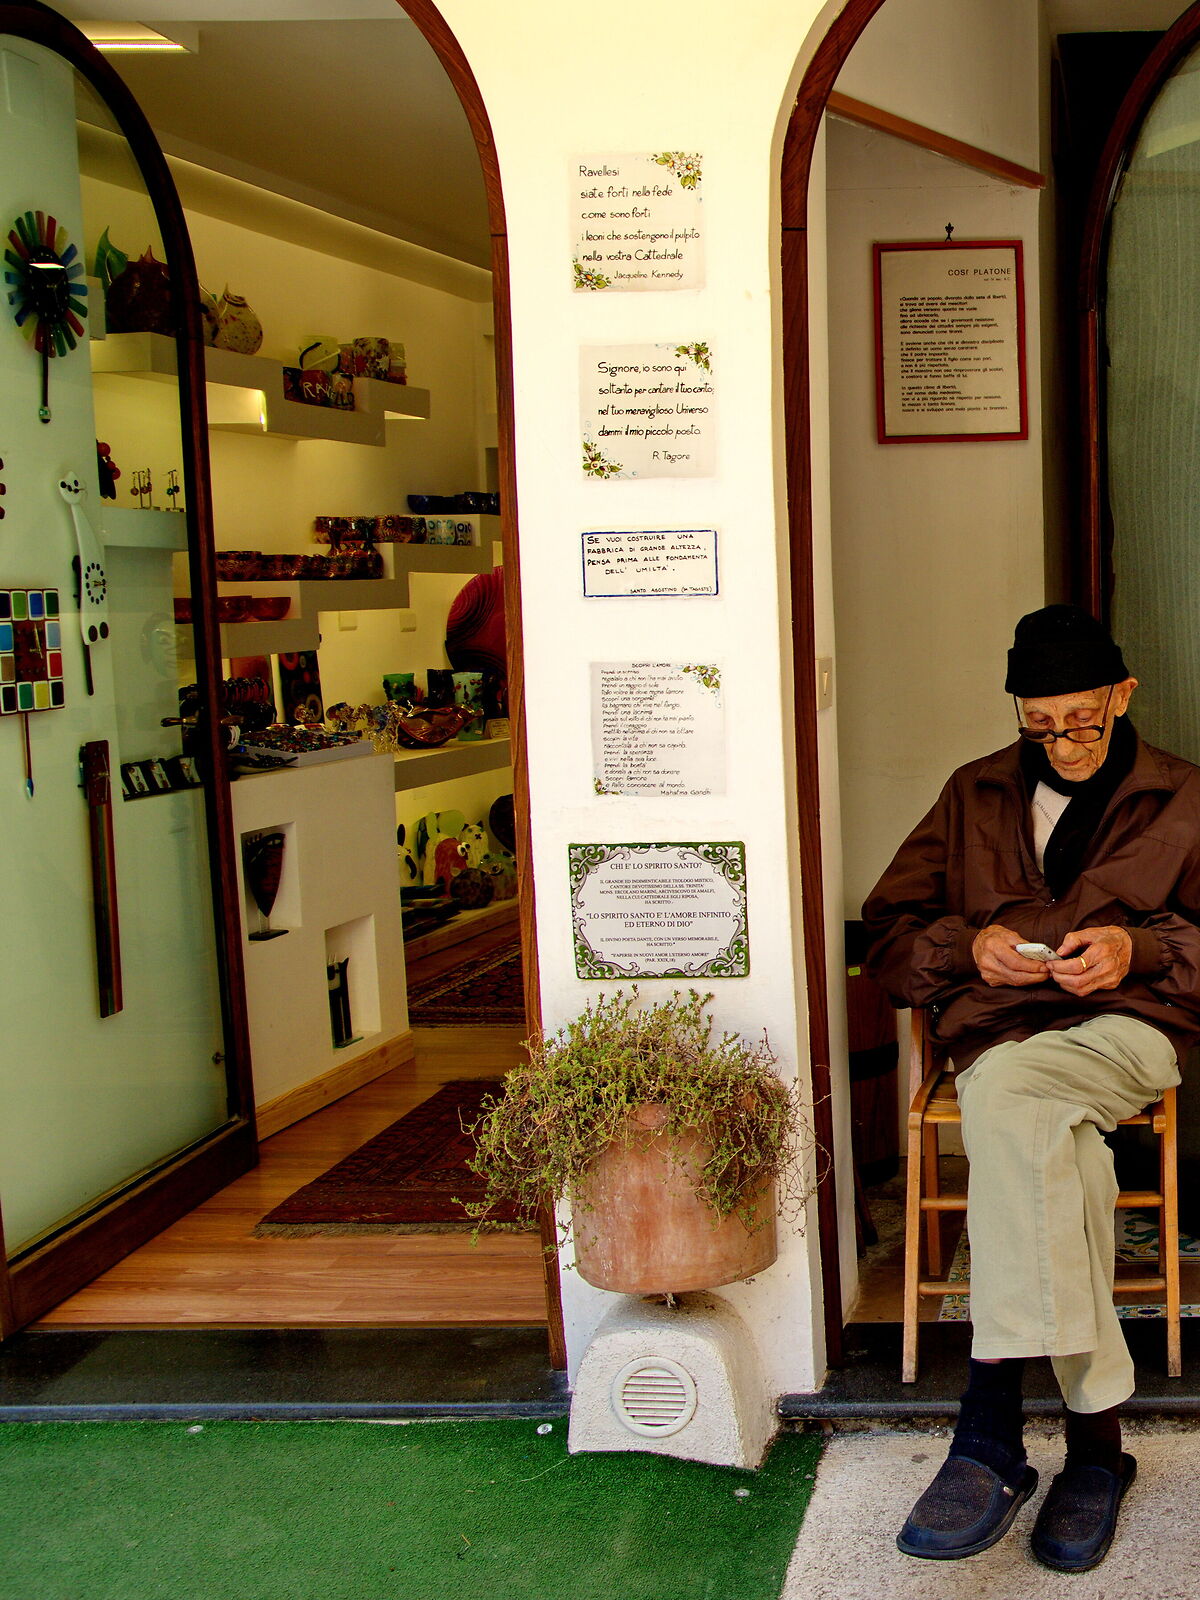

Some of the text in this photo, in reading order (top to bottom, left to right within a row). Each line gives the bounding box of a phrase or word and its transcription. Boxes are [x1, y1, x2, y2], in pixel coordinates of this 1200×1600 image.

[579, 165, 620, 177] Ravellesi
[581, 185, 673, 199] siate forti nella fede
[632, 207, 651, 218] forti
[586, 230, 605, 241] leoni
[607, 230, 622, 240] che
[624, 229, 670, 243] sostengono
[670, 229, 674, 239] il
[675, 227, 700, 243] pulpito
[583, 249, 683, 261] nella vostra Cattedrale
[614, 270, 684, 282] Jacqueline Kennedy
[598, 362, 641, 377] Signore,
[643, 364, 650, 372] io
[674, 366, 687, 376] qui
[599, 383, 632, 394] soltanto
[634, 388, 647, 397] per
[648, 382, 674, 393] cantare
[675, 382, 679, 393] il
[680, 382, 692, 393] tuo
[598, 403, 708, 419] nel tuo meraviglioso Universo
[598, 424, 700, 439] dammi il mio piccolo posto
[662, 451, 690, 463] Tagore
